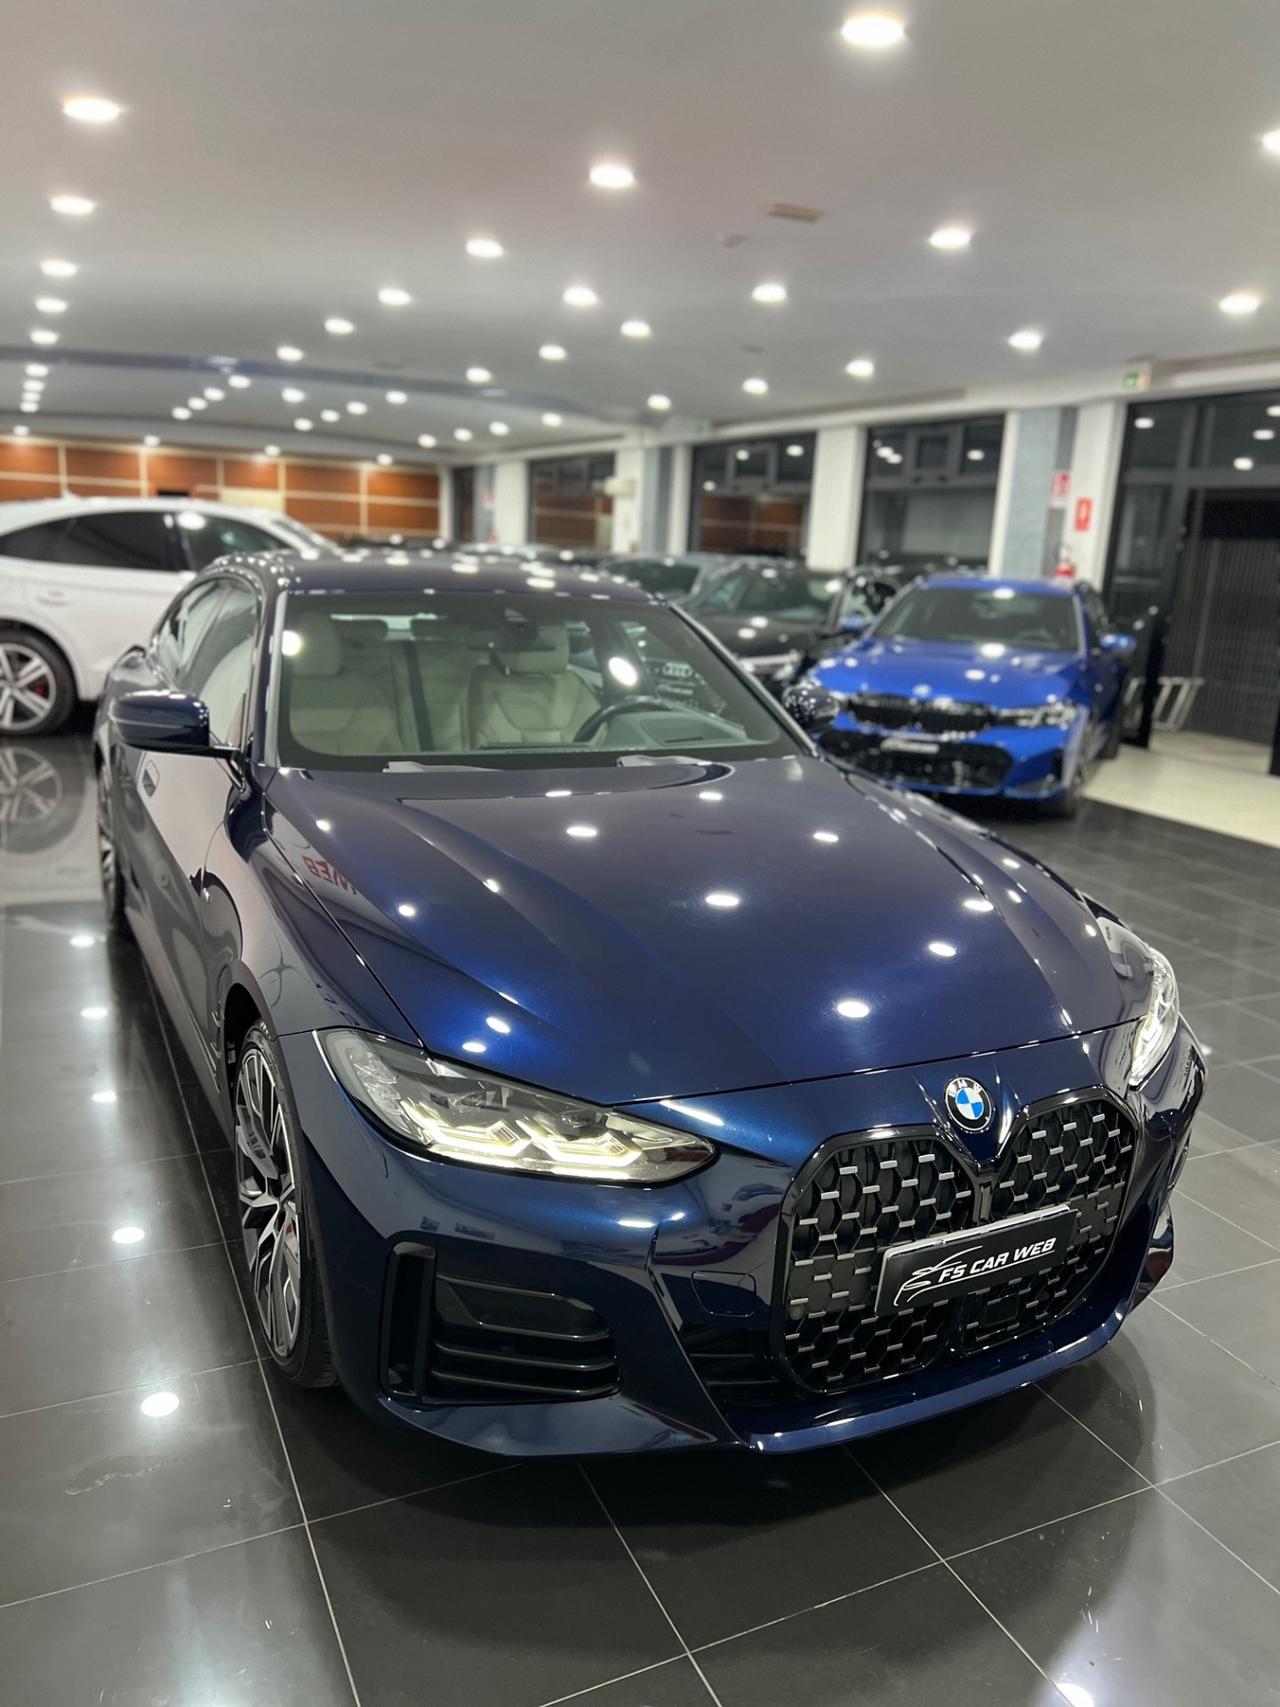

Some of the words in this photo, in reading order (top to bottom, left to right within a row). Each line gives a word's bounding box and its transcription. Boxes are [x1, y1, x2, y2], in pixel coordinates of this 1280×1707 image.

[938, 1264, 968, 1283] FS
[970, 1252, 1010, 1274] CAR
[1013, 1237, 1057, 1261] WEB
